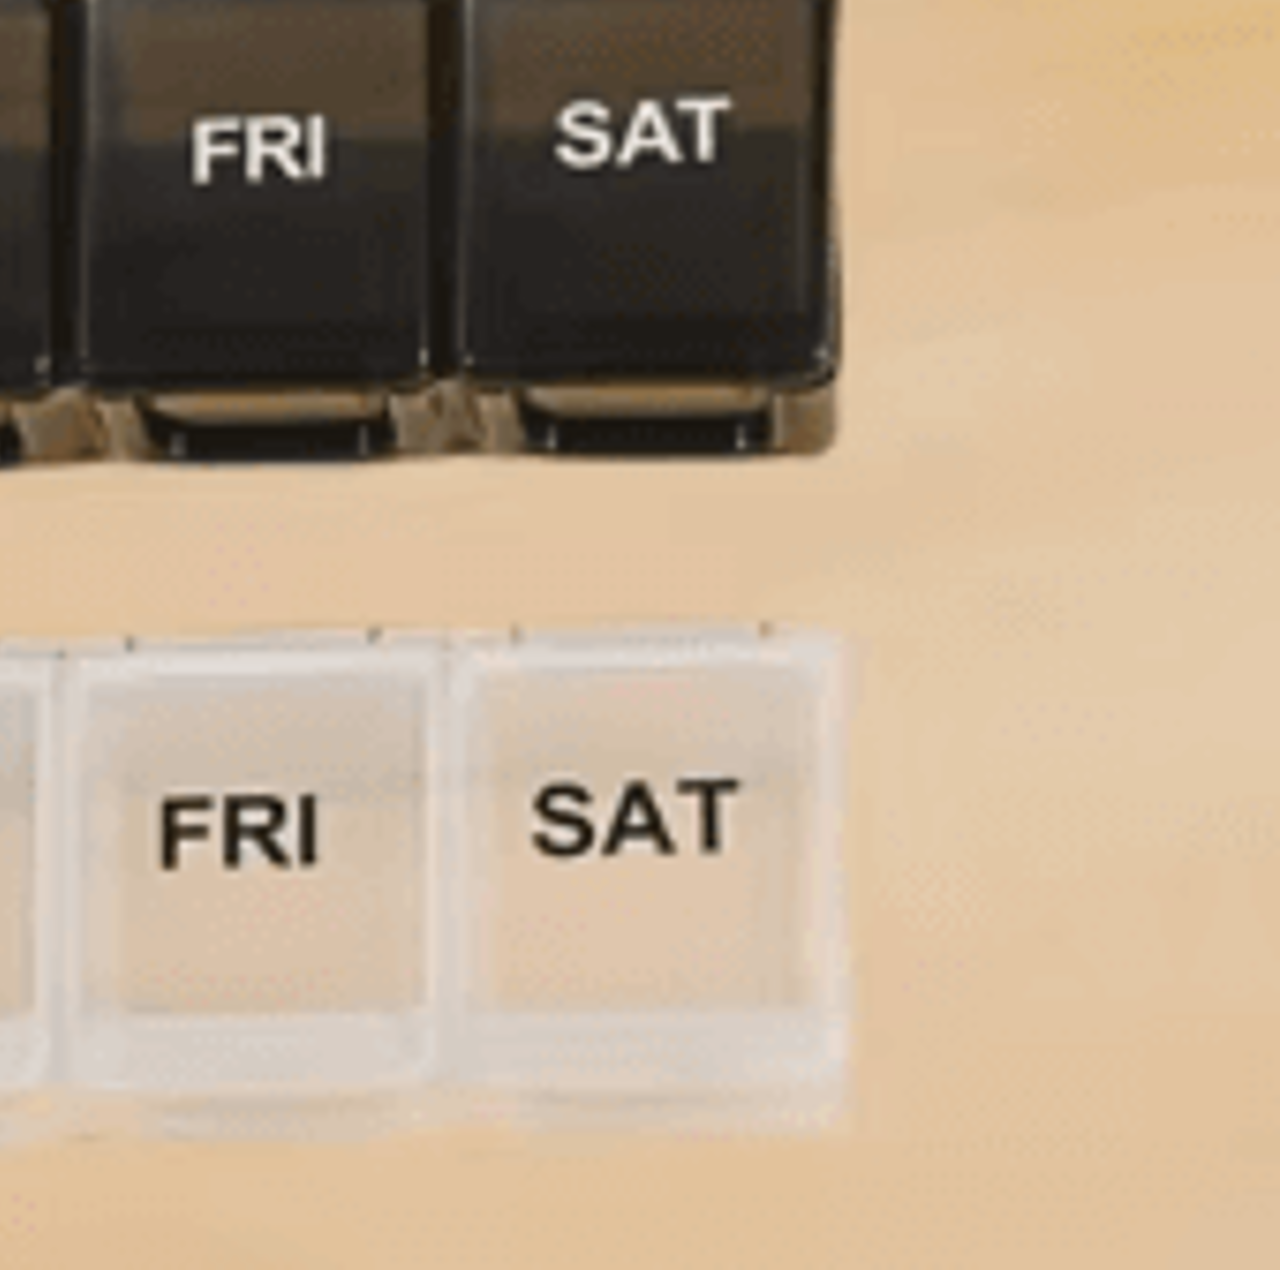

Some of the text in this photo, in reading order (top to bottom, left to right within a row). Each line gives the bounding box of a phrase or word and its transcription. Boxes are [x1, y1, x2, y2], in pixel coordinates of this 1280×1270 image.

[192, 113, 326, 184] FRI
[554, 96, 733, 169] SAT
[159, 792, 319, 873] FRI
[531, 777, 741, 859] SAT
